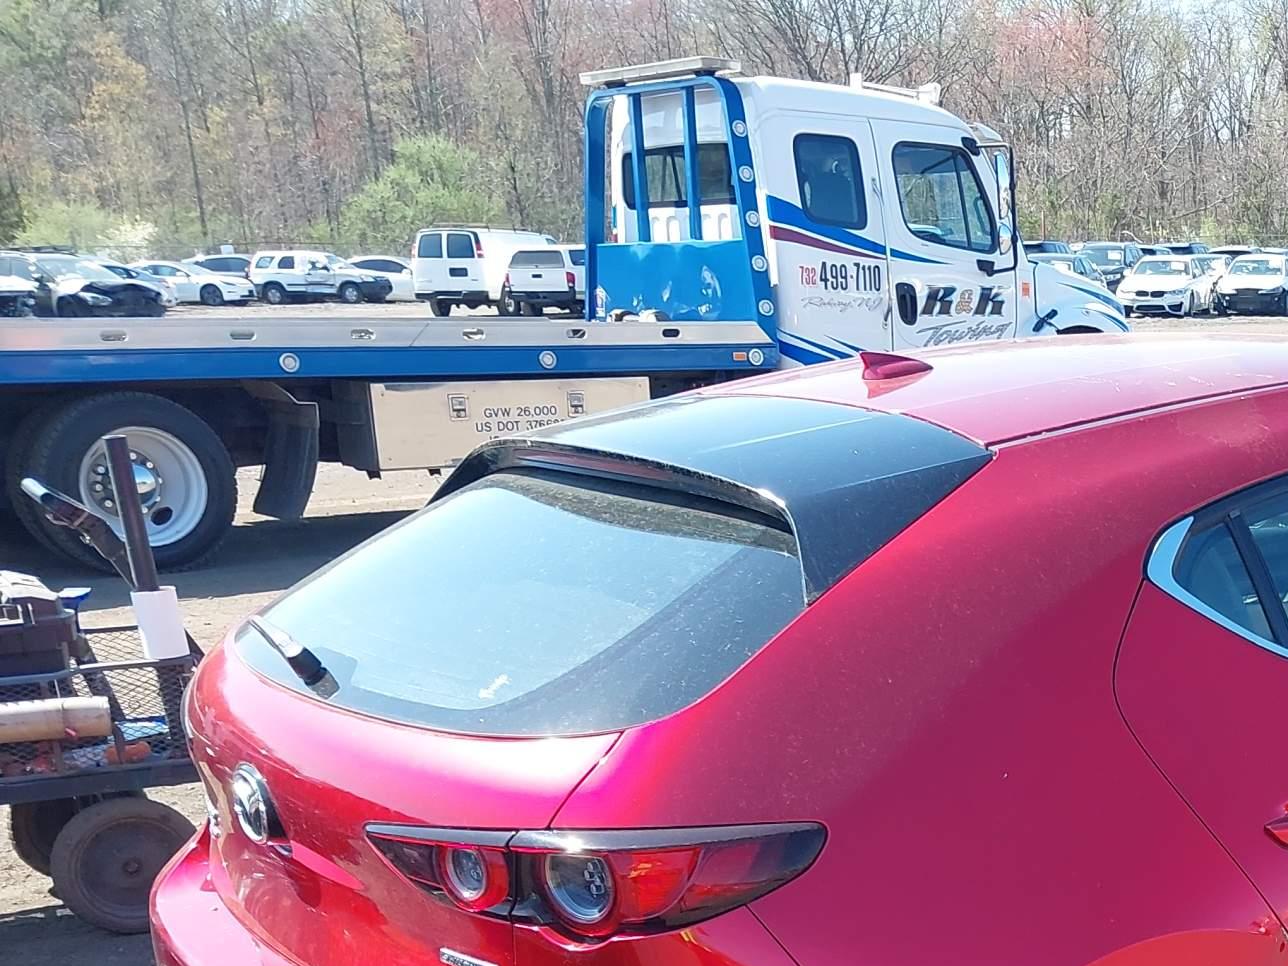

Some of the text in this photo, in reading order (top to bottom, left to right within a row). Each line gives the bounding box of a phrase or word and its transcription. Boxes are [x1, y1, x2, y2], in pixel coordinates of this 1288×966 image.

[799, 265, 817, 286] 732
[915, 319, 1013, 347] Towing
[483, 405, 557, 419] GVW 26,000
[475, 421, 492, 433] US
[497, 420, 520, 432] DOT
